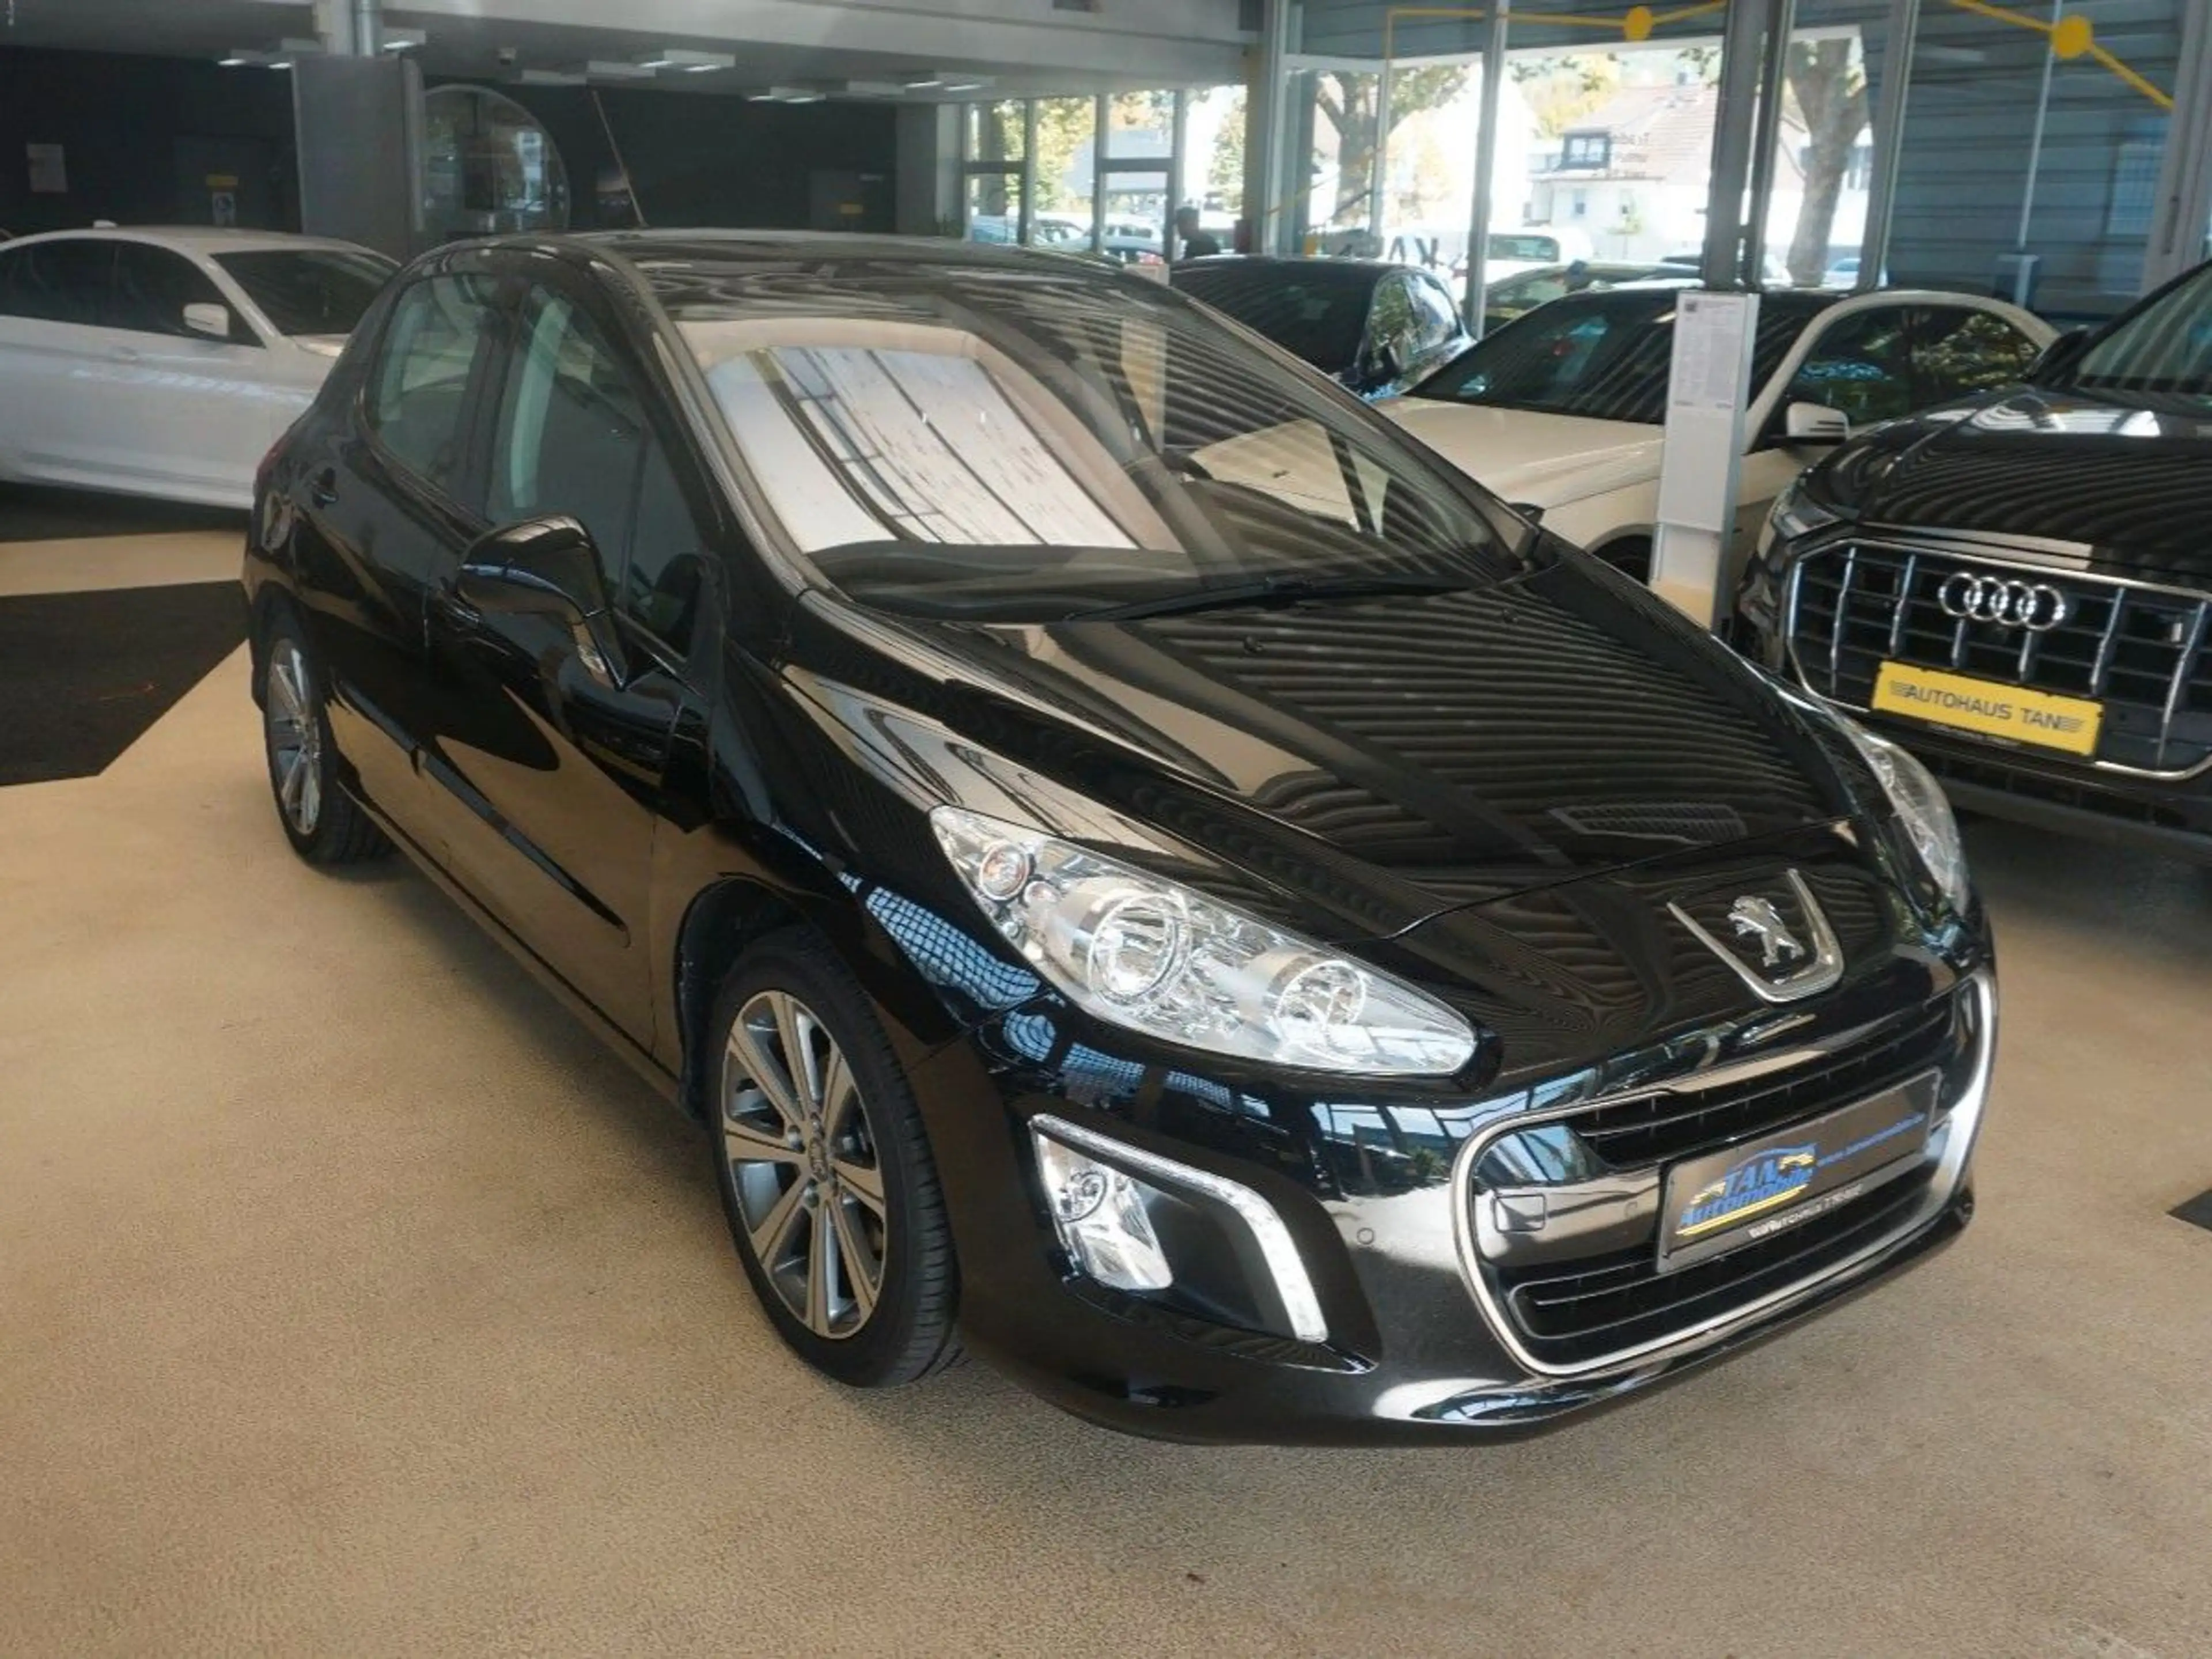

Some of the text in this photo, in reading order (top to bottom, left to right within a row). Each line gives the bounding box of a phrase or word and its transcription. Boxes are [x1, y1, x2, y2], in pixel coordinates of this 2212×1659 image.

[1904, 683, 2065, 731] AUTOHAUS TAN
[1724, 1160, 1776, 1197] TAN
